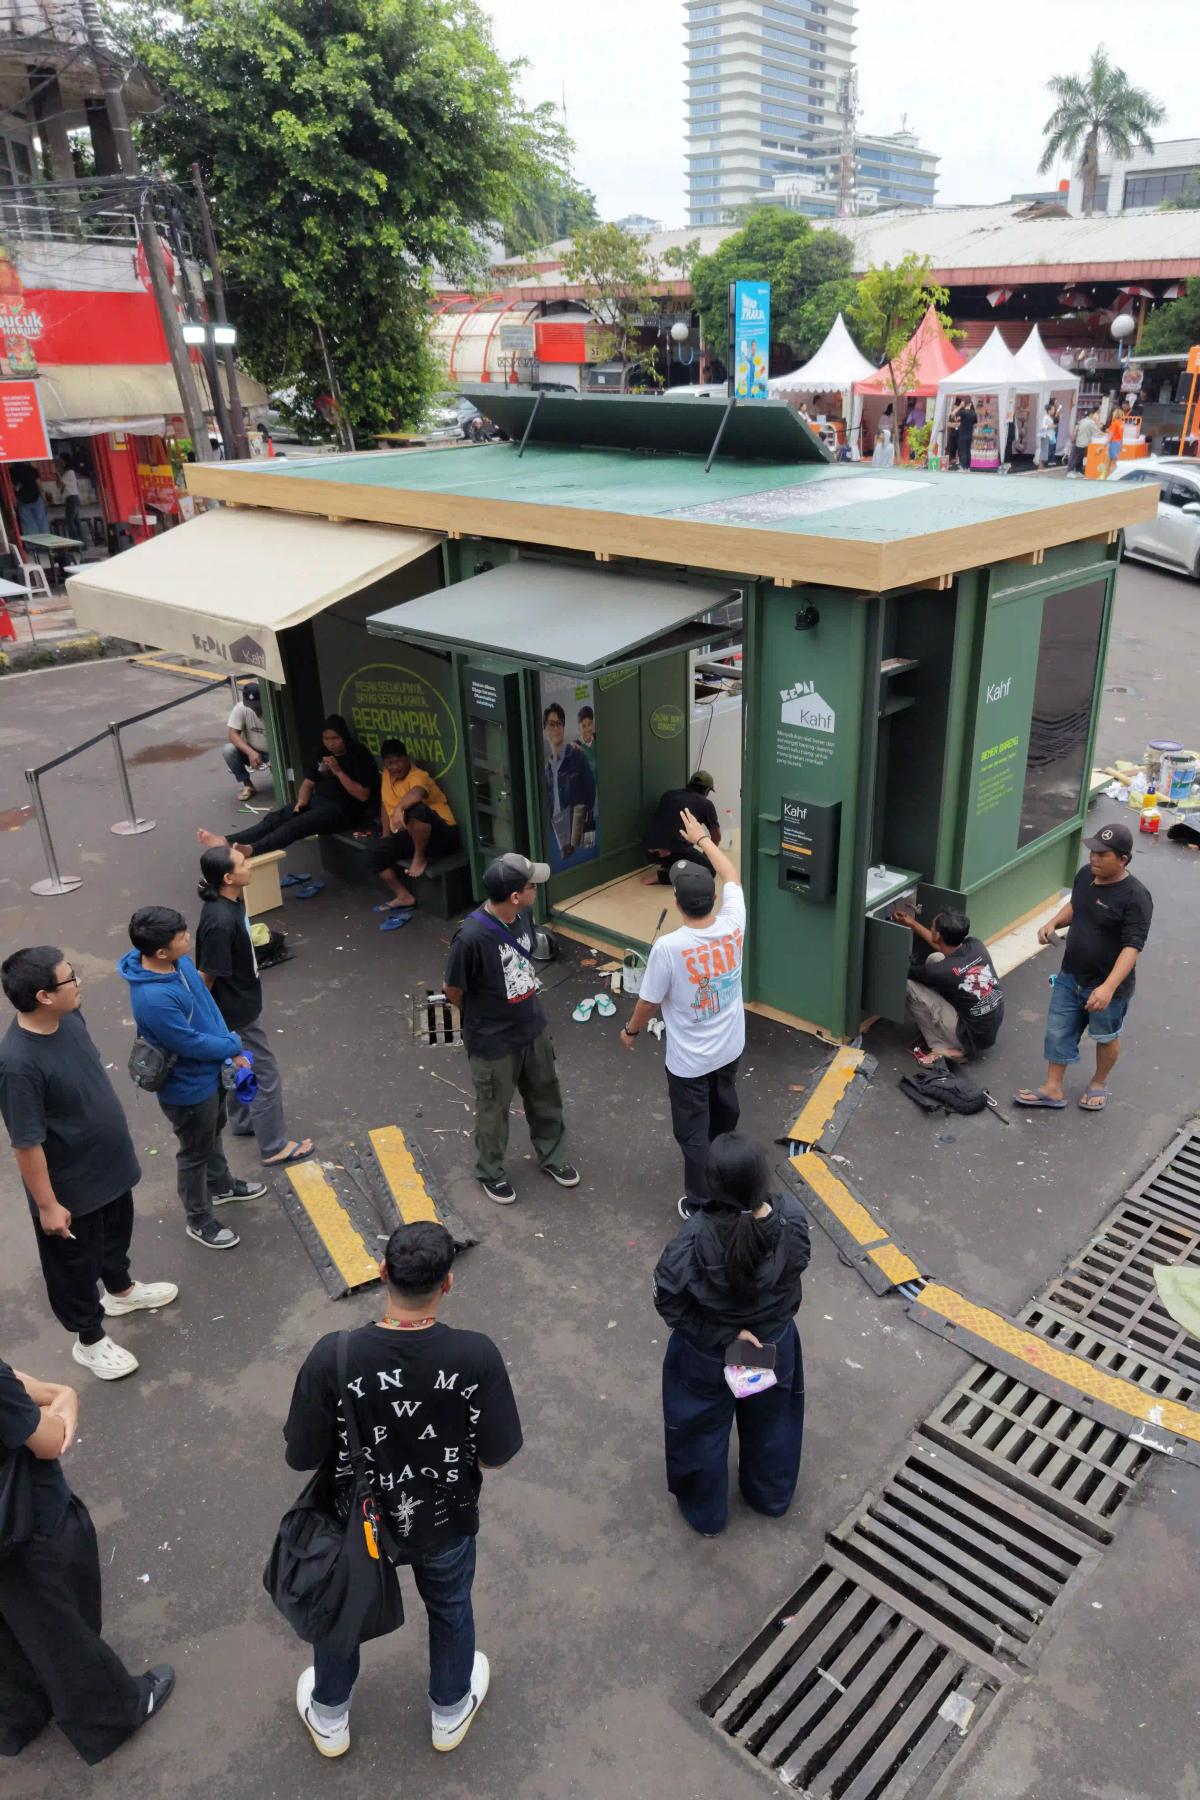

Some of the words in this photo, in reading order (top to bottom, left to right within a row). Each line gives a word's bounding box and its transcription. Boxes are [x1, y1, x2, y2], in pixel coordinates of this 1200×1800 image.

[986, 677, 1012, 704] Kahf
[352, 707, 441, 737] BERDAMPAK
[800, 709, 832, 729] Kahf
[784, 803, 807, 819] Kahf
